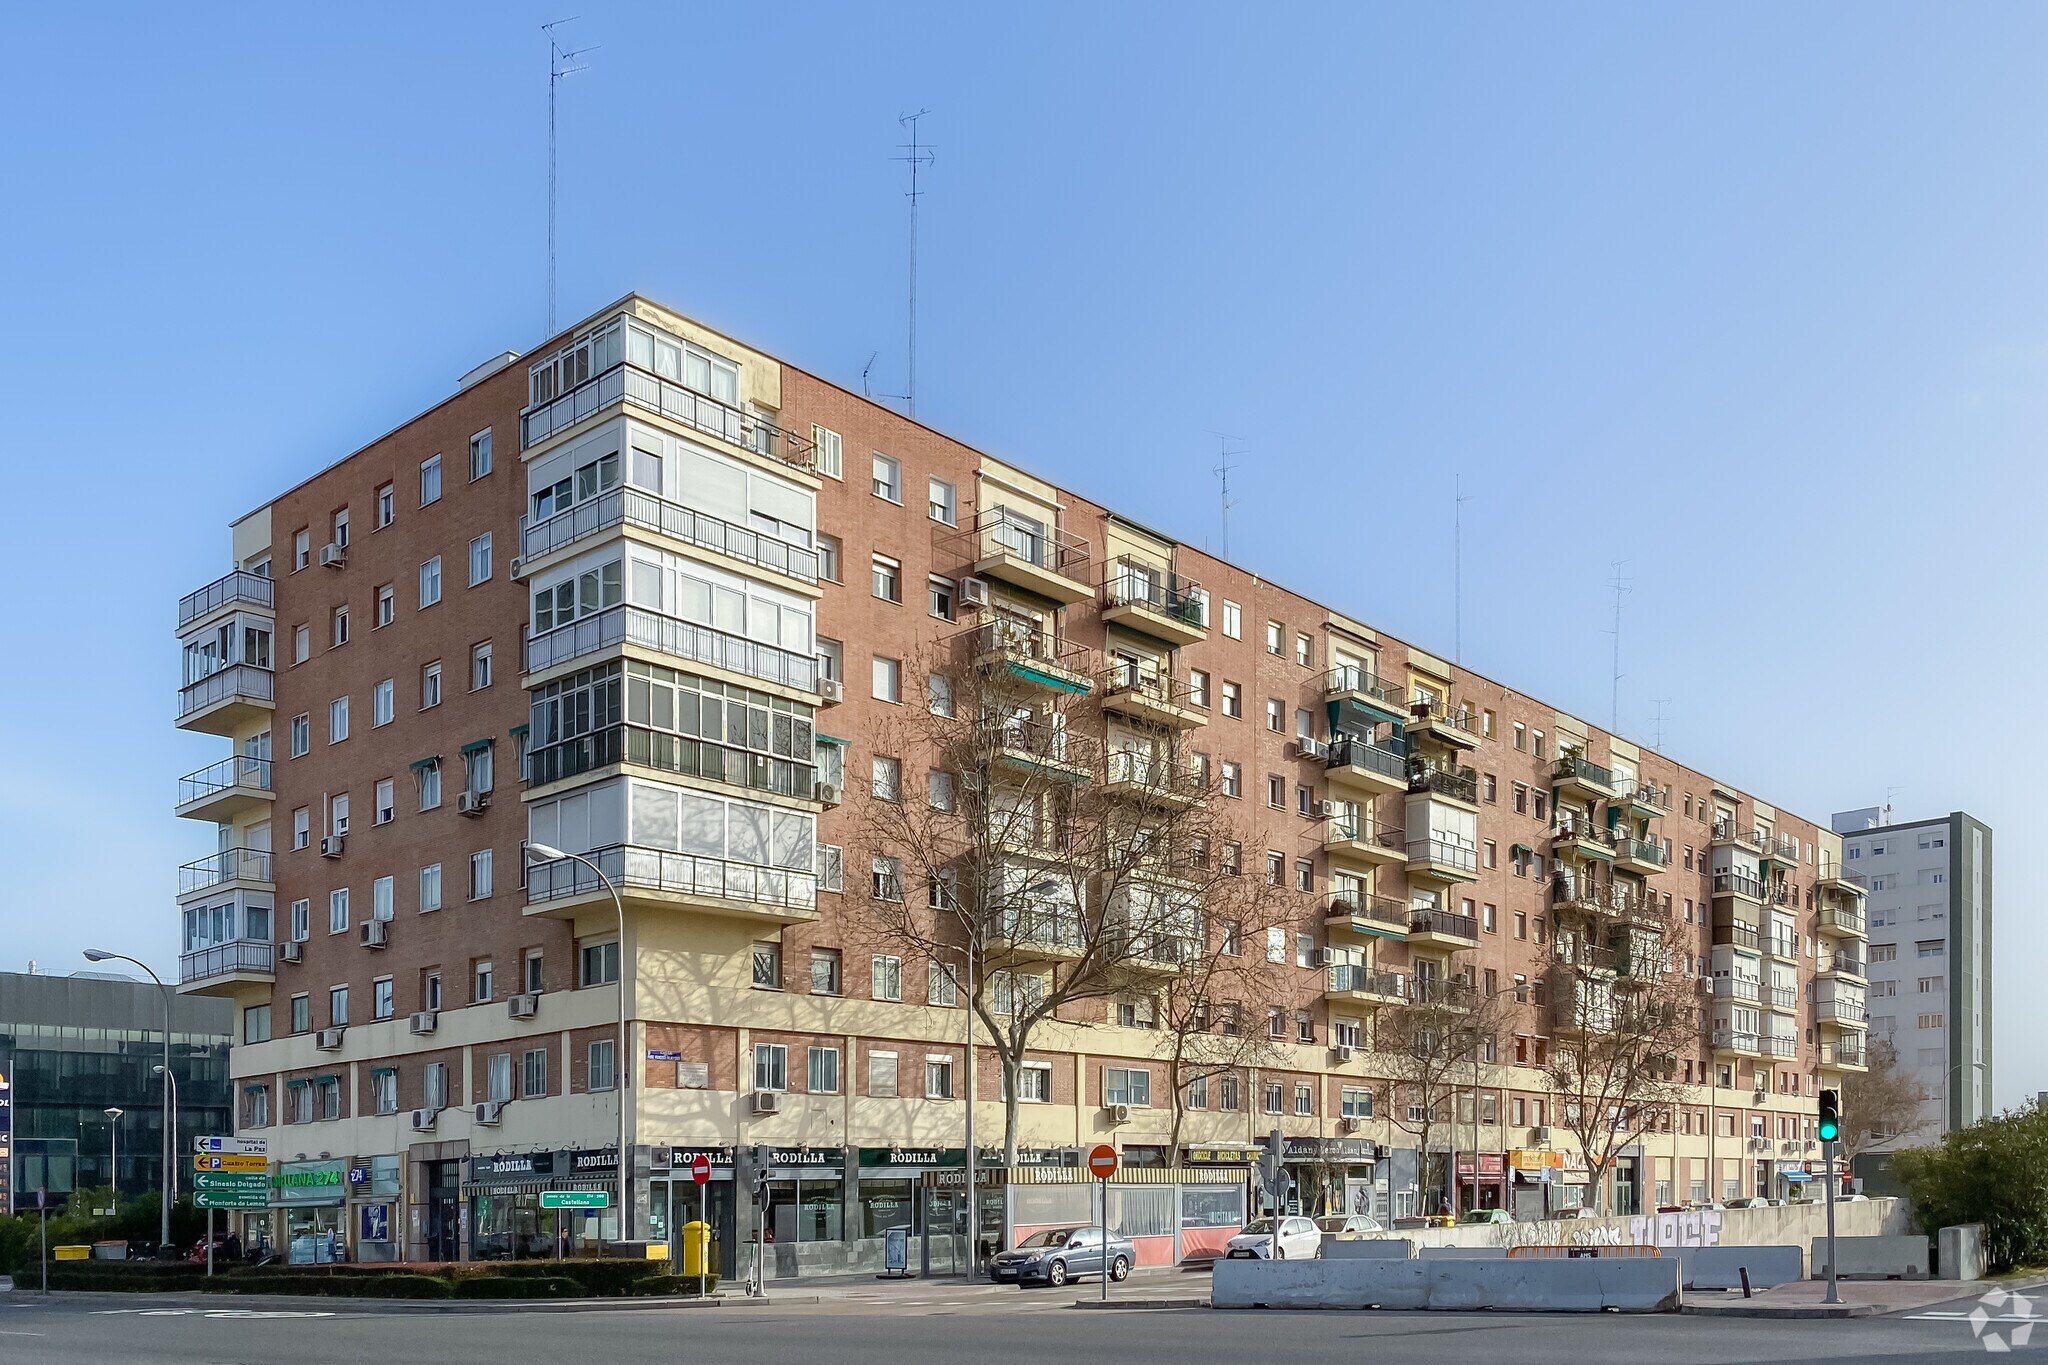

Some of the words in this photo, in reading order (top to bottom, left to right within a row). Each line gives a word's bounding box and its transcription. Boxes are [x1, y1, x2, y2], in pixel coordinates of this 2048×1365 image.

[577, 1154, 619, 1167] RODILLA
[772, 1152, 826, 1163] RODILLA
[890, 1153, 937, 1163] RODILLA
[493, 1159, 532, 1172] RODILLA
[317, 1170, 339, 1186] 274
[939, 1172, 987, 1184] RODILA
[1035, 1170, 1073, 1181] RODILLA
[870, 1201, 899, 1209] RODILLA
